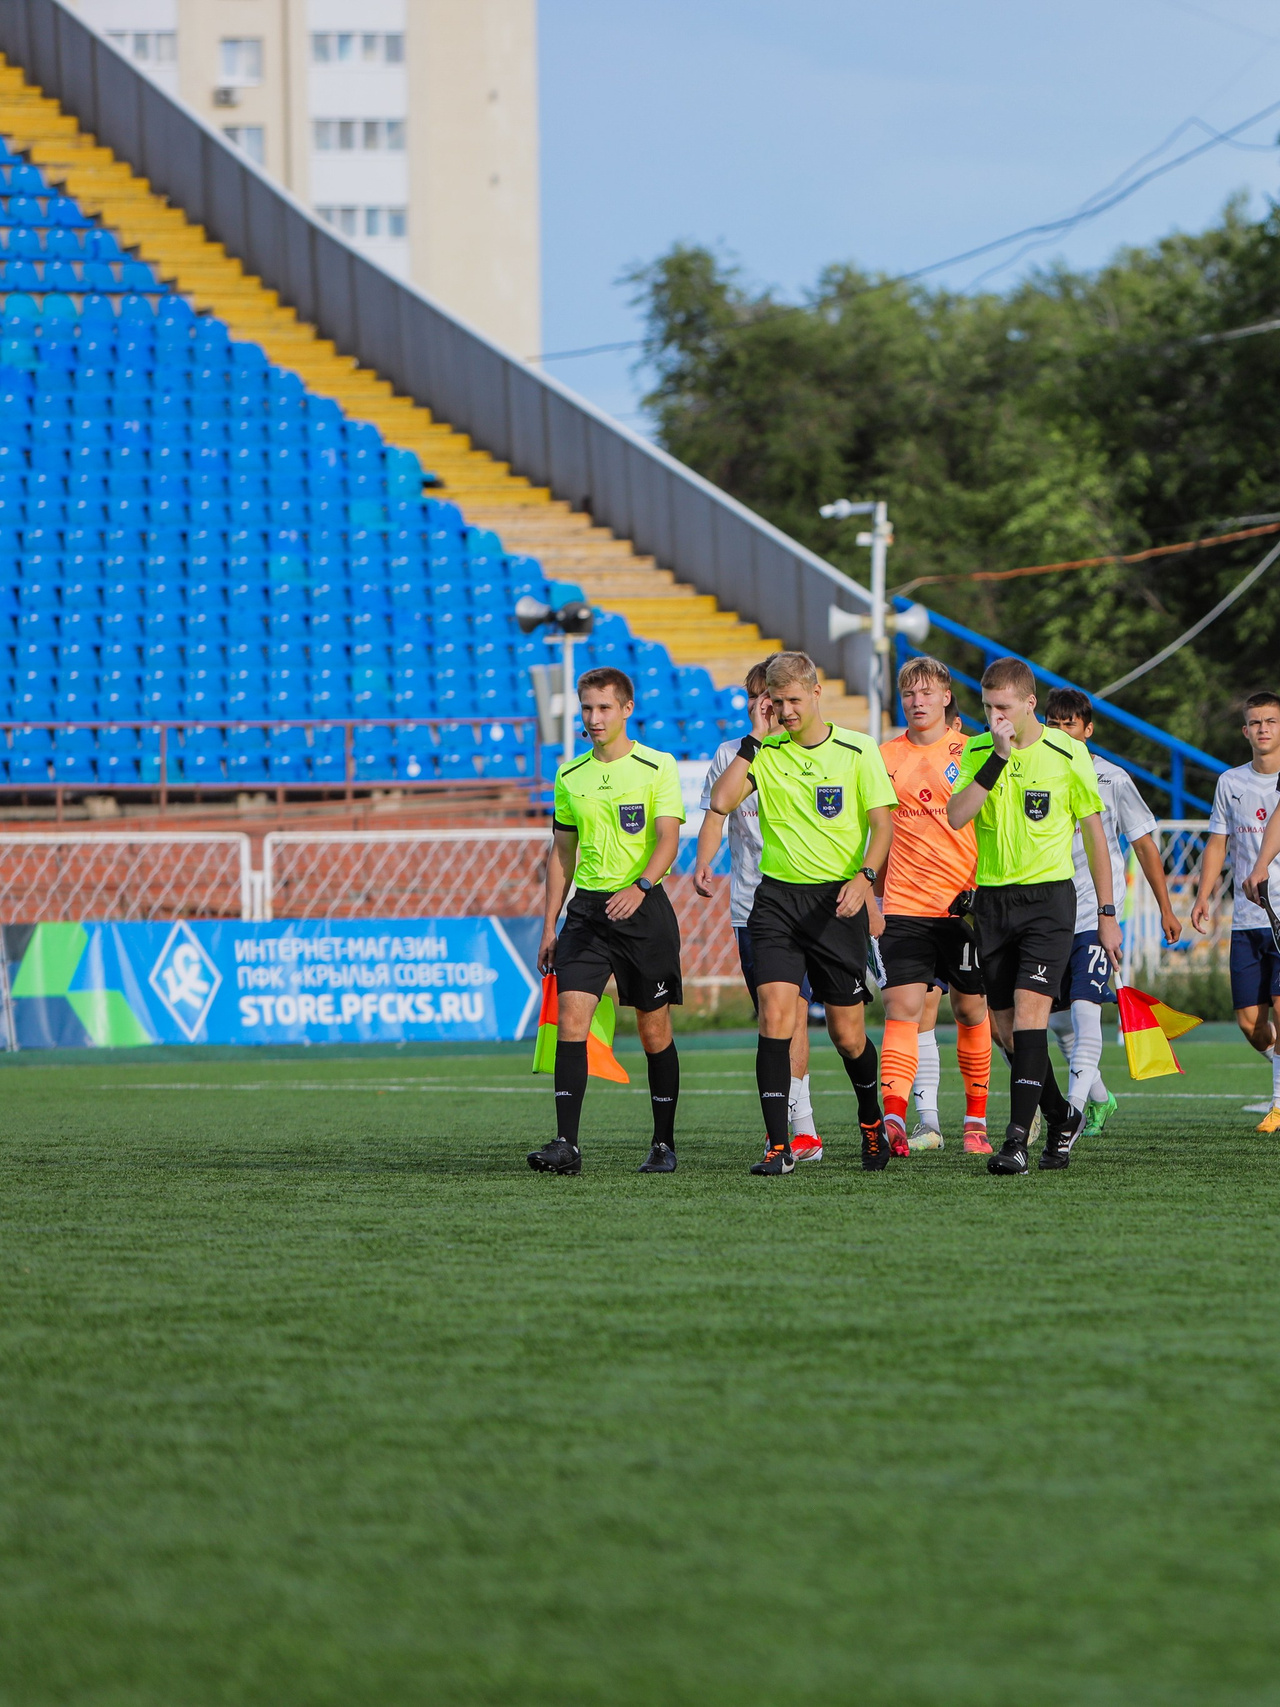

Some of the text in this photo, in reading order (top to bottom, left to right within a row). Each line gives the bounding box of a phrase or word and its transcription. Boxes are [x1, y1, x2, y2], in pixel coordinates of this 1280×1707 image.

[234, 936, 448, 963] ИНТЕРНЕТ-МАГАЗИН
[1087, 944, 1108, 976] 75
[237, 962, 499, 990] ПФК «КРЫЛЬЯ СОВЕТОВ»
[239, 992, 485, 1027] STORE.PFCKS.RU
